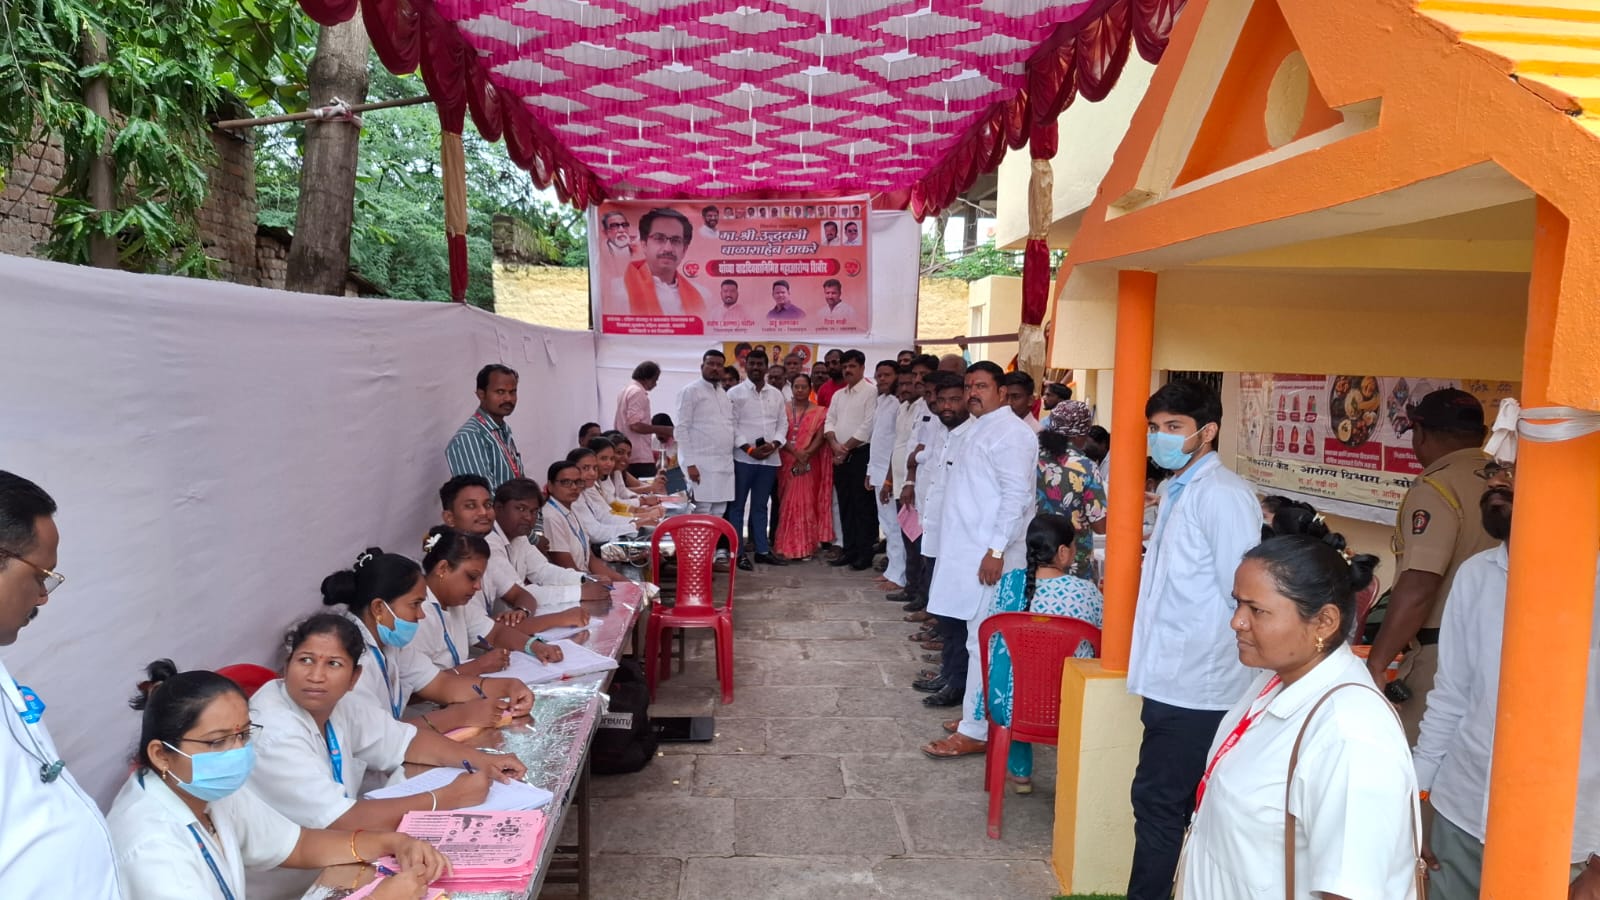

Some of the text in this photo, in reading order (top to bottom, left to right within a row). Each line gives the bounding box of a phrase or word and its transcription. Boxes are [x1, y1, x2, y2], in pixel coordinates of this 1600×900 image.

[785, 242, 819, 254] ठाकरे
[1300, 465, 1338, 477] आरोग्य
[1341, 469, 1380, 483] विभाग
